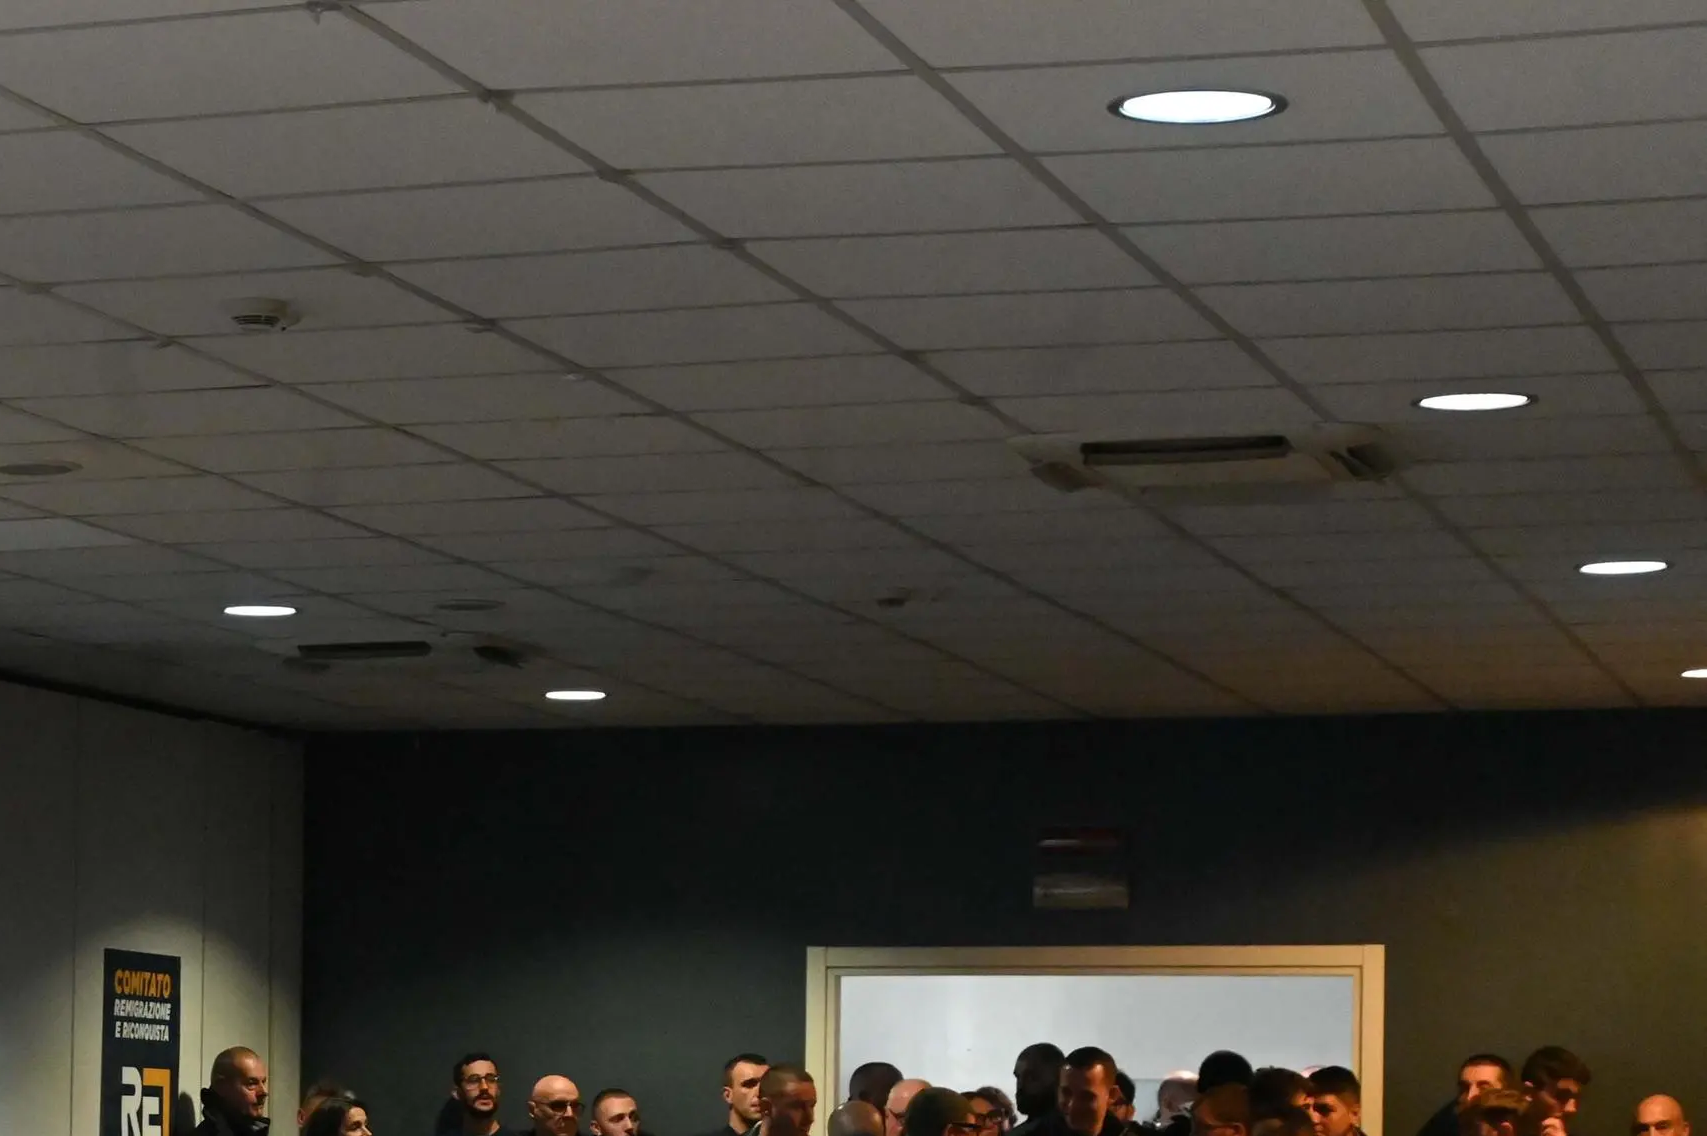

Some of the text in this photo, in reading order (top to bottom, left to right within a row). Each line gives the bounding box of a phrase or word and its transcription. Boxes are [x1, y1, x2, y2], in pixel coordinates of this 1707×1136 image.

[114, 969, 171, 999] COMITATO
[114, 999, 171, 1020] REMIGRAZIONE
[115, 1021, 170, 1041] E RICONQUISTA
